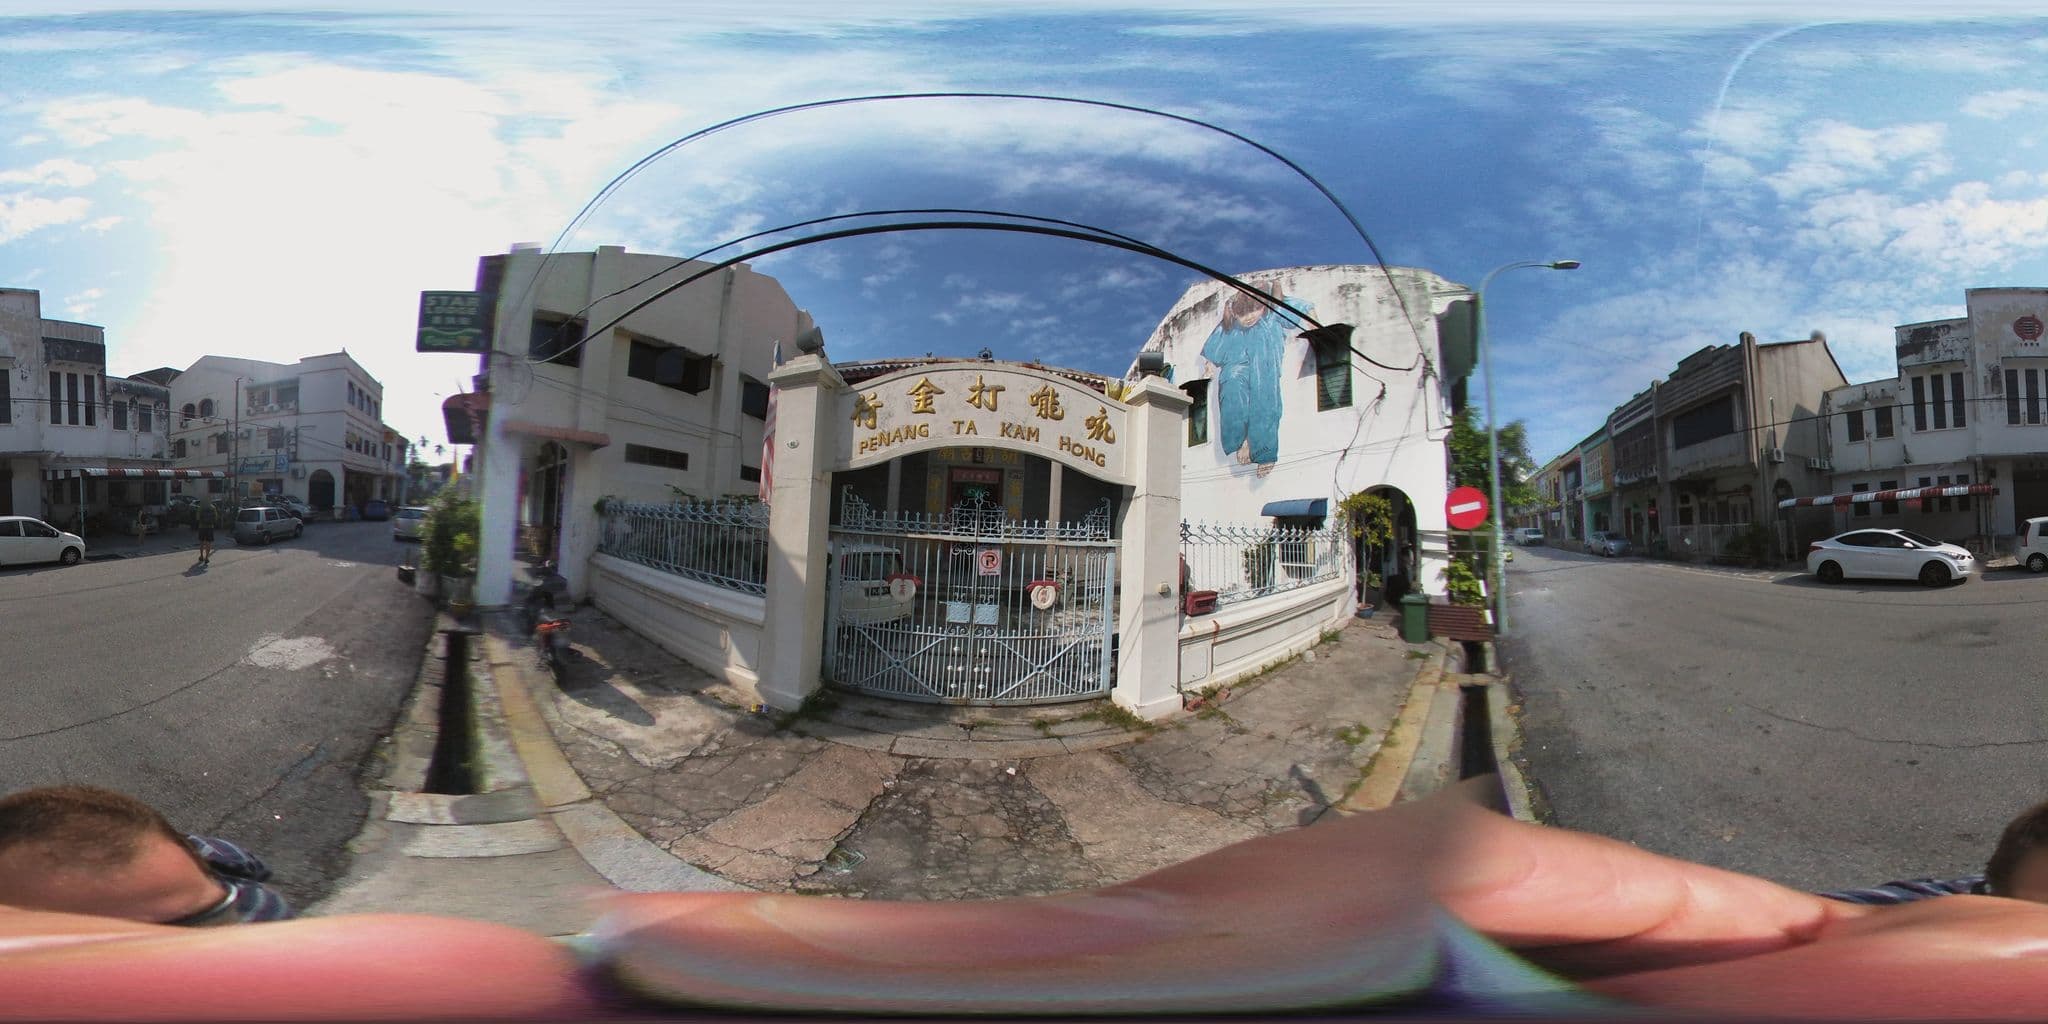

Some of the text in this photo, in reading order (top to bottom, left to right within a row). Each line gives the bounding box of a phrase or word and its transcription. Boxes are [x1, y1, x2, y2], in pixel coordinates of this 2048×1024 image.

[859, 421, 1106, 468] PENANG TA KAM HONG
